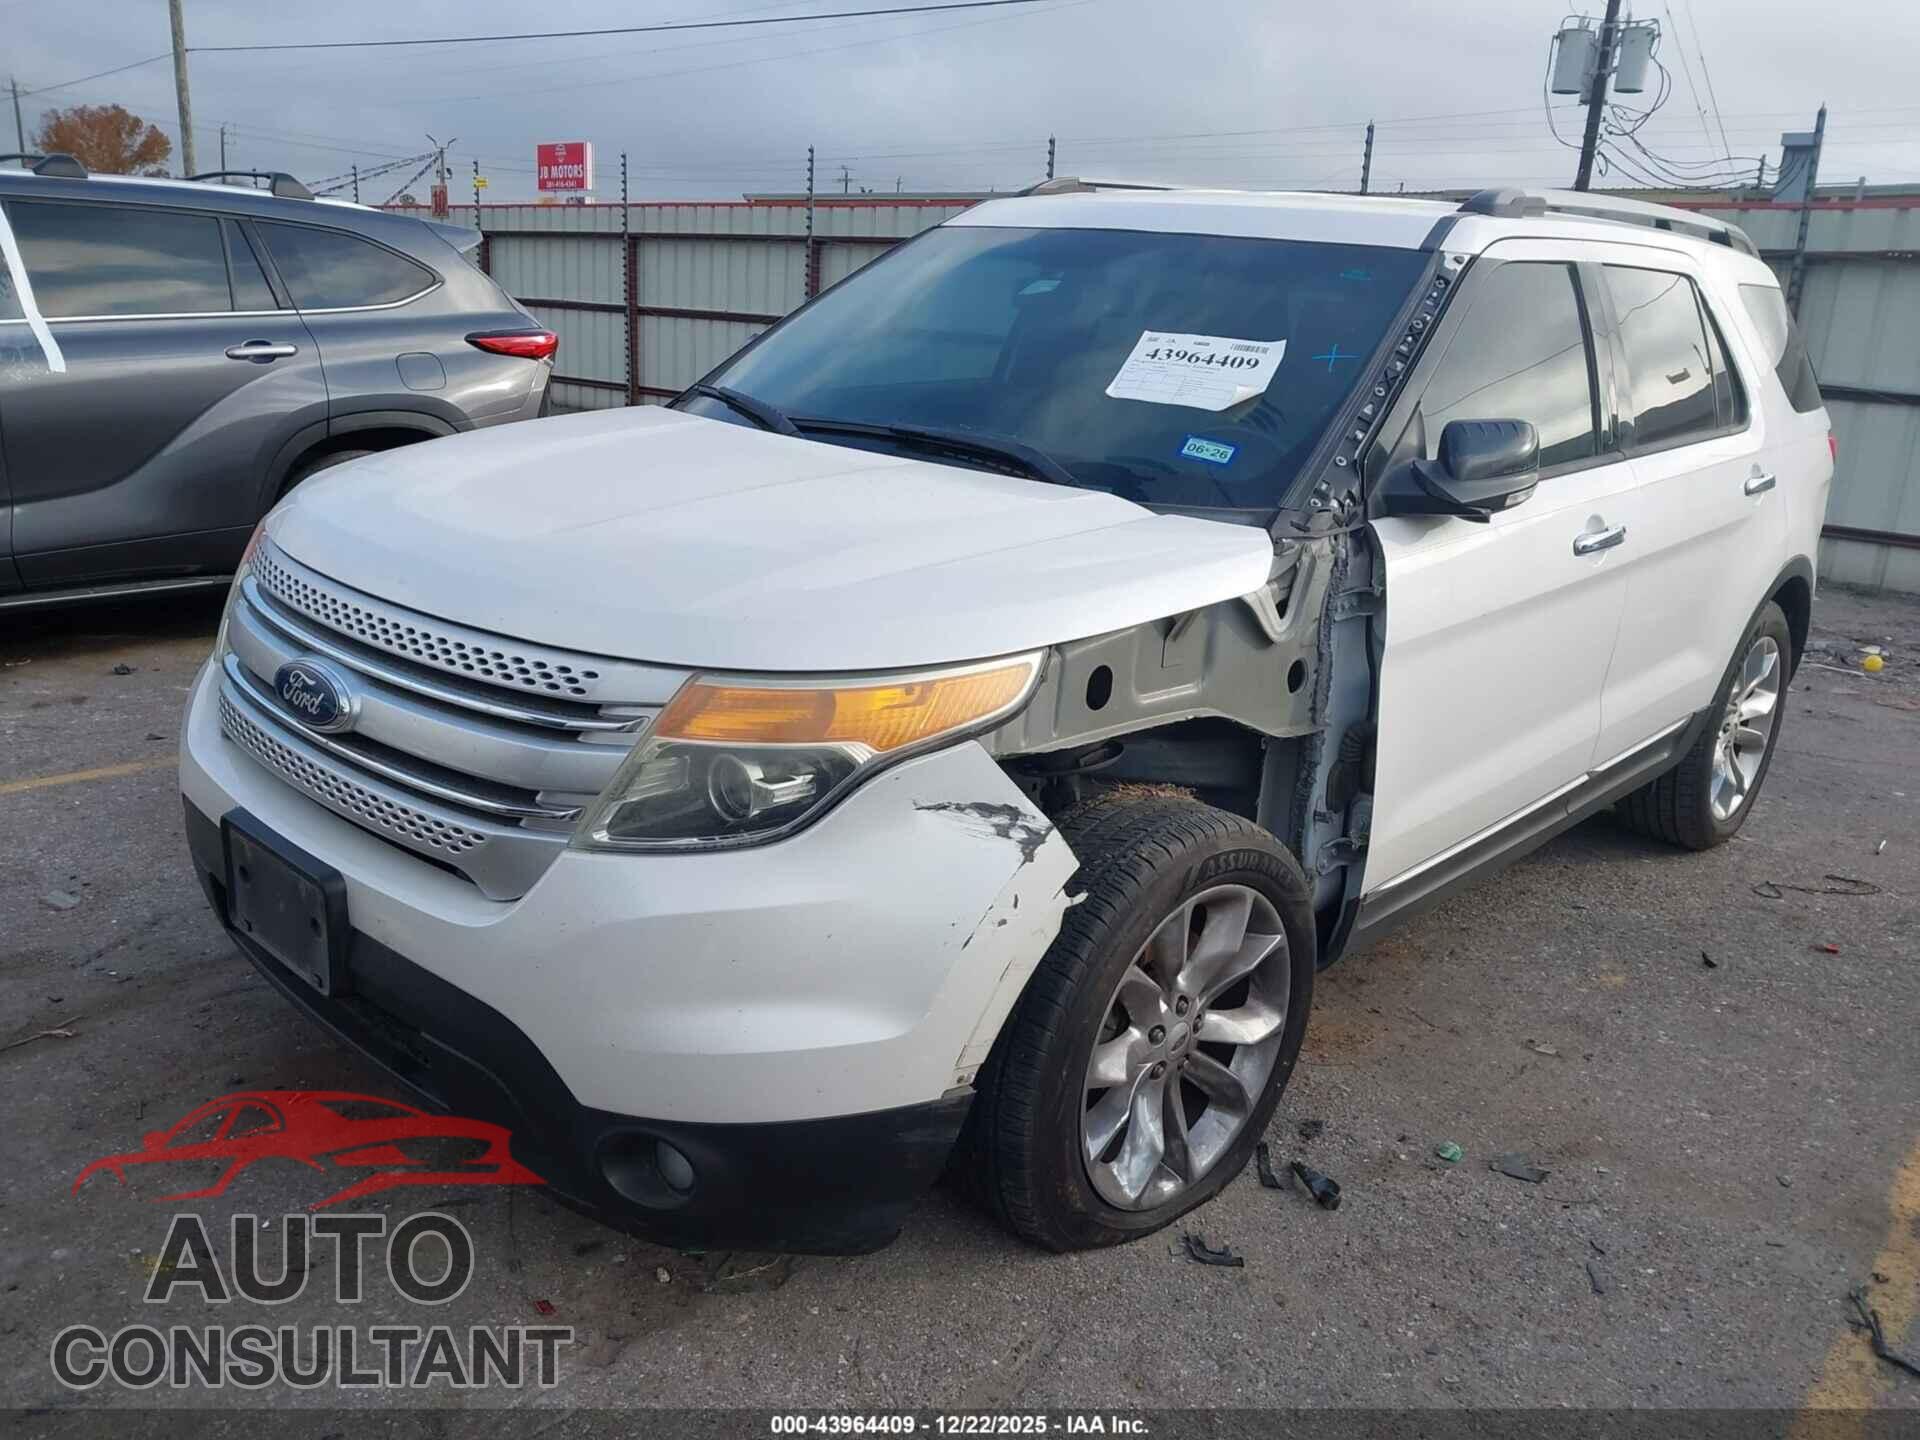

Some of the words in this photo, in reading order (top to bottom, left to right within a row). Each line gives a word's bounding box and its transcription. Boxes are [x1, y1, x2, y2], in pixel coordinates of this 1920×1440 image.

[551, 164, 583, 179] MOTORS
[1145, 347, 1260, 370] 43964409
[283, 670, 325, 715] Ford
